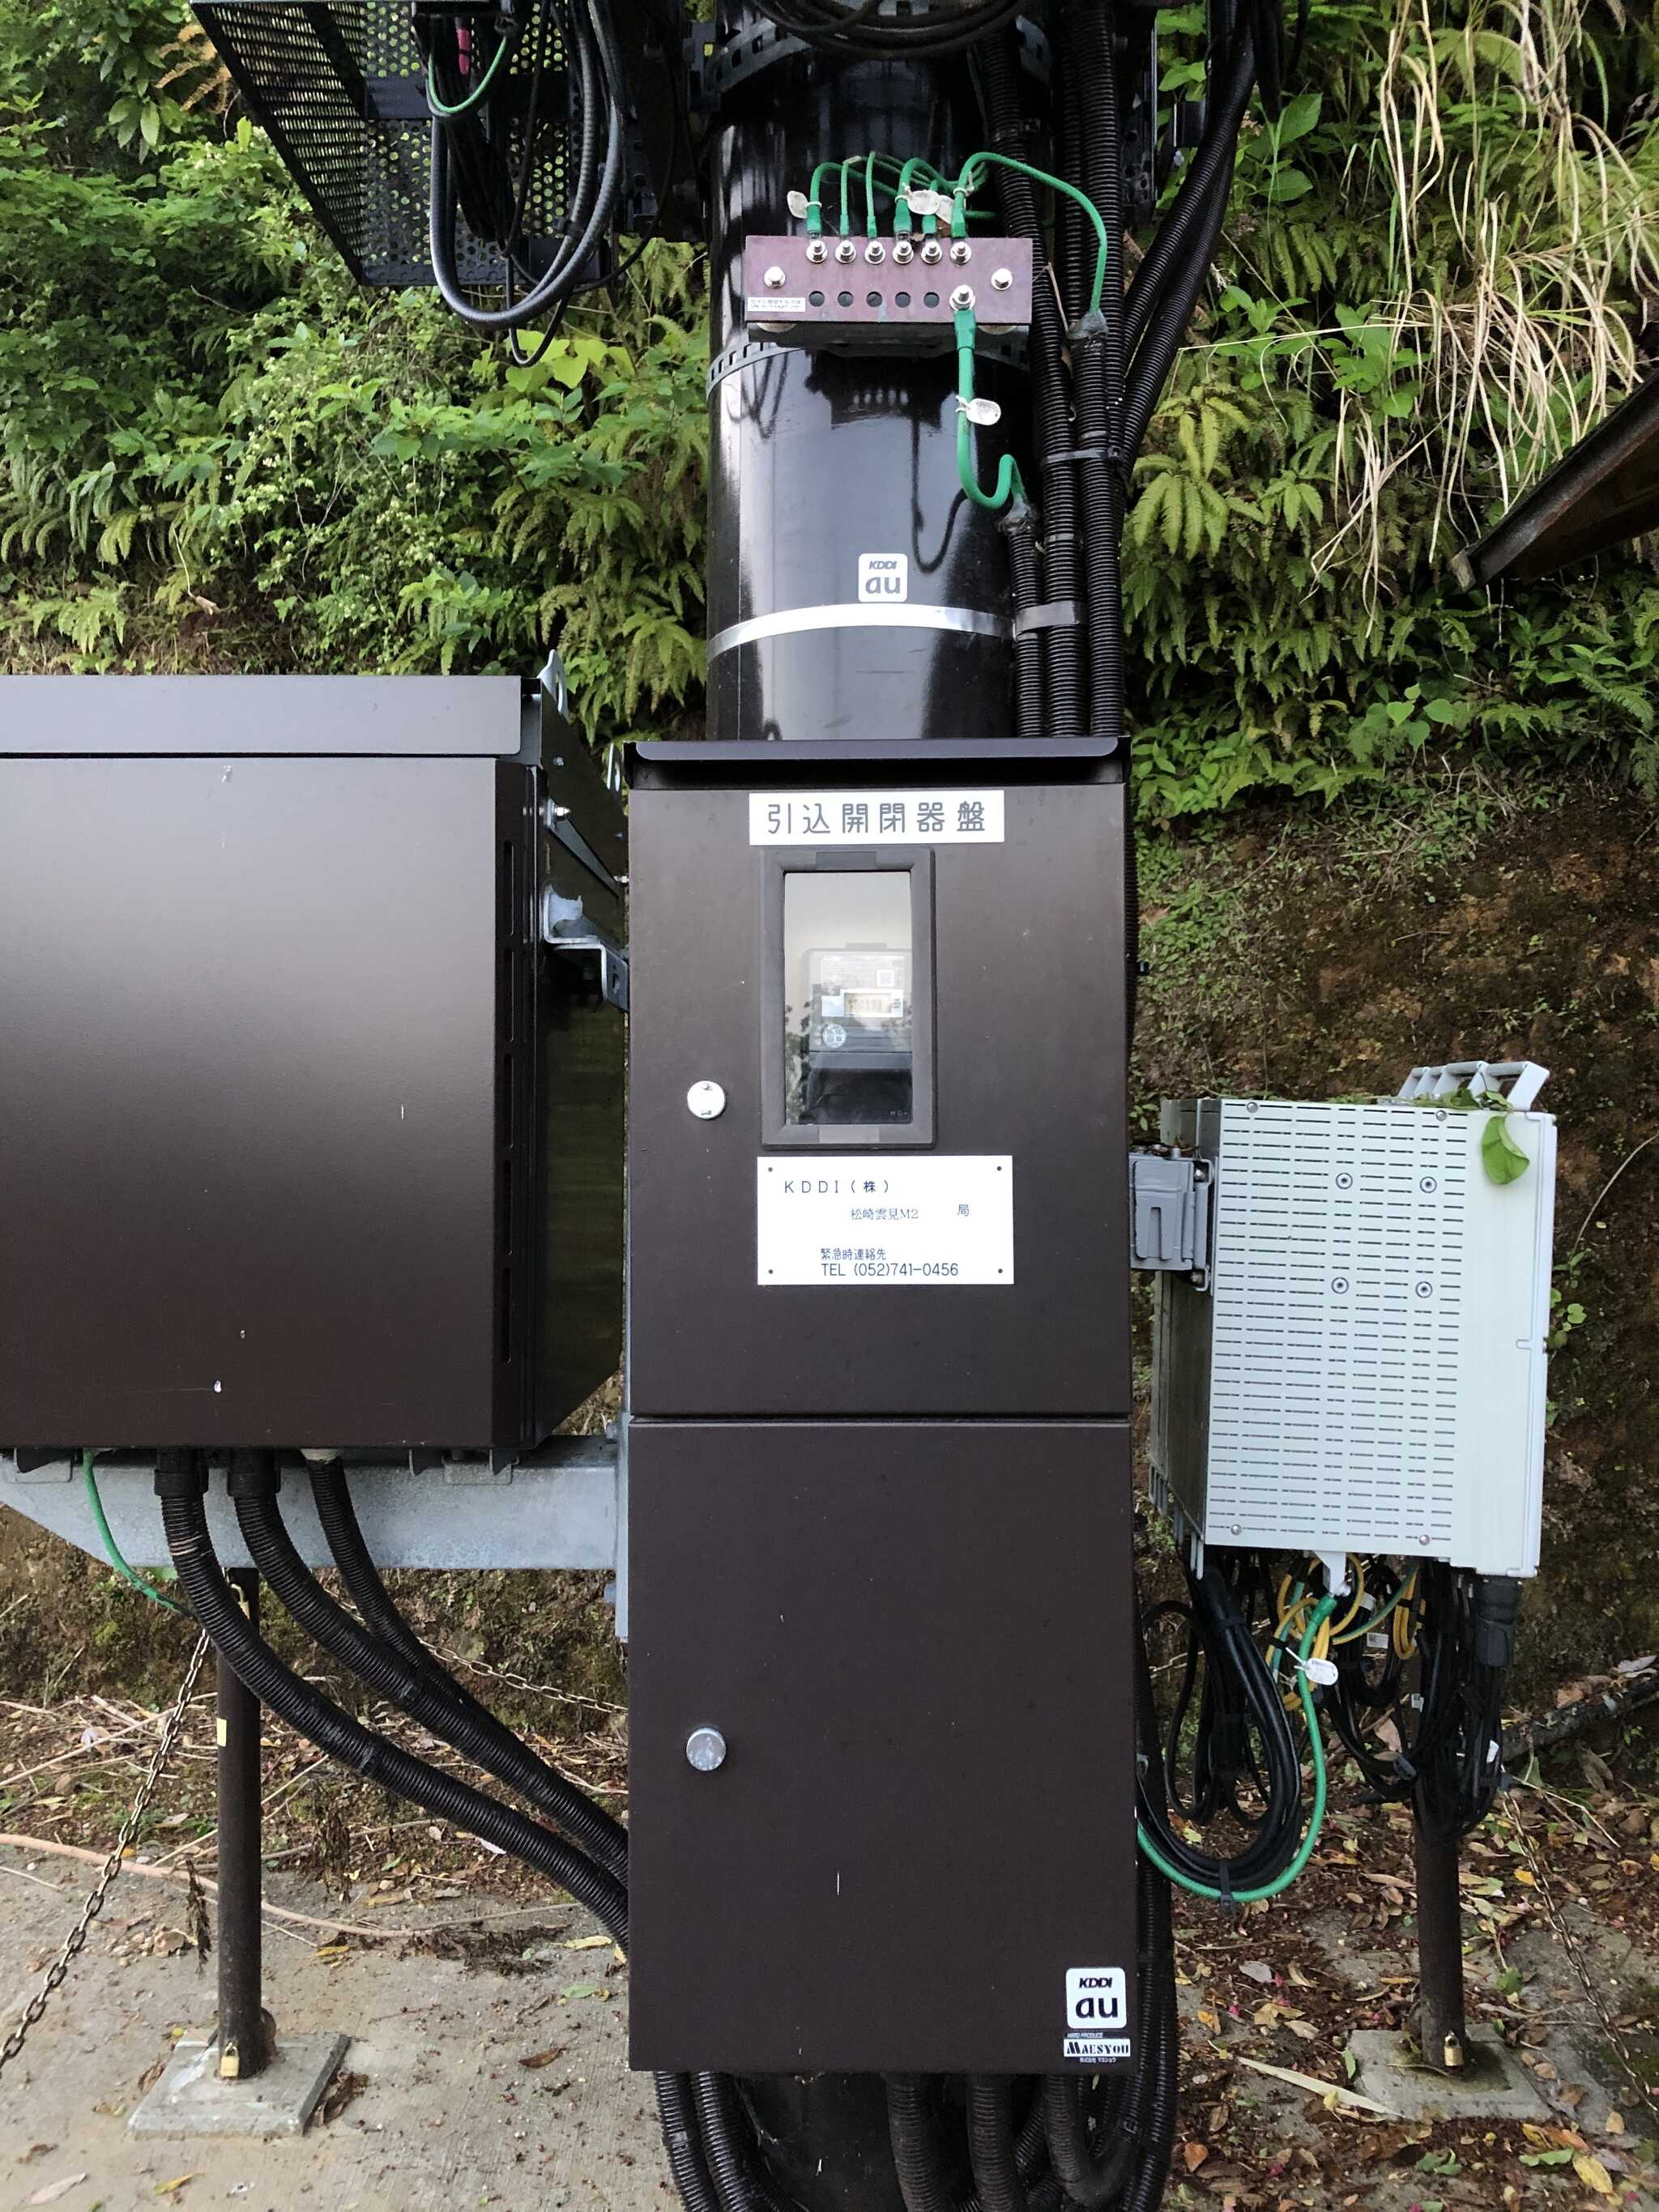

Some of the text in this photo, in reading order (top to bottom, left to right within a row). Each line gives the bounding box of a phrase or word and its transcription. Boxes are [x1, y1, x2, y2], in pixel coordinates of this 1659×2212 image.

[868, 560, 898, 570] KDDI
[865, 576, 901, 595] au
[767, 800, 986, 834] 引込開閉器盤
[956, 1204, 970, 1217] 局
[821, 1247, 887, 1260] 緊急時連絡先
[821, 1263, 959, 1277] TEL (052)741-0456
[1079, 1977, 1113, 1988] KDDI
[1075, 1997, 1119, 2018] au
